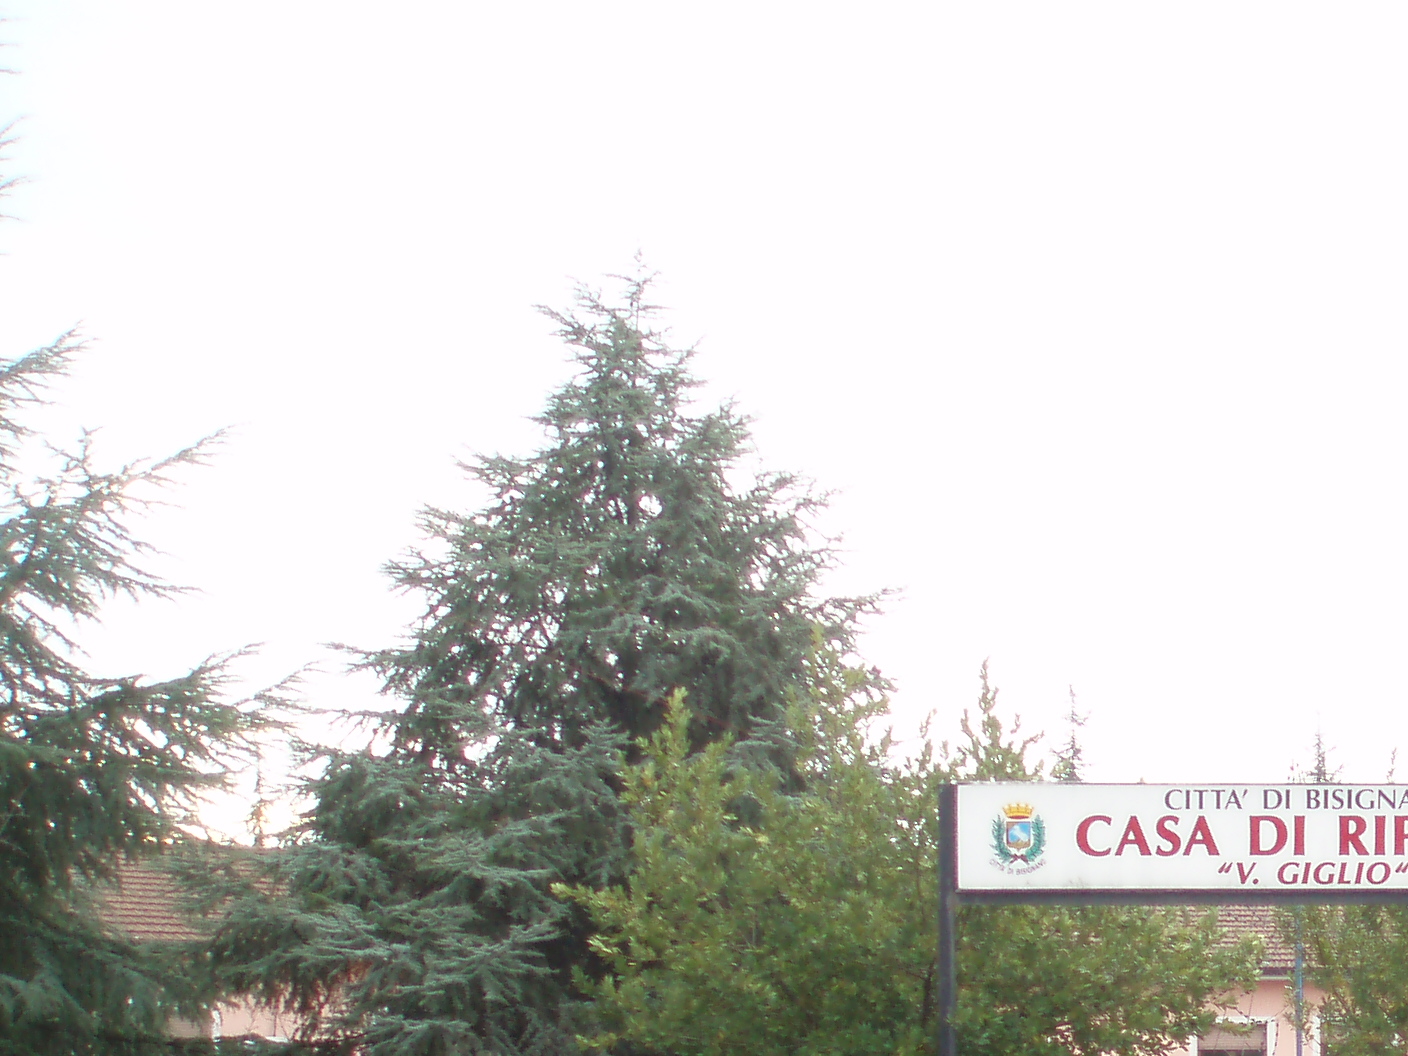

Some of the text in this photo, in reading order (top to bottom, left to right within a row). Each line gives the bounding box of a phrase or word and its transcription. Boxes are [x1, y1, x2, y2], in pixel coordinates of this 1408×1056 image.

[1164, 788, 1248, 811] CITTA'
[1262, 788, 1291, 810] DI
[1075, 814, 1221, 857] CASA
[1249, 814, 1306, 856] DI
